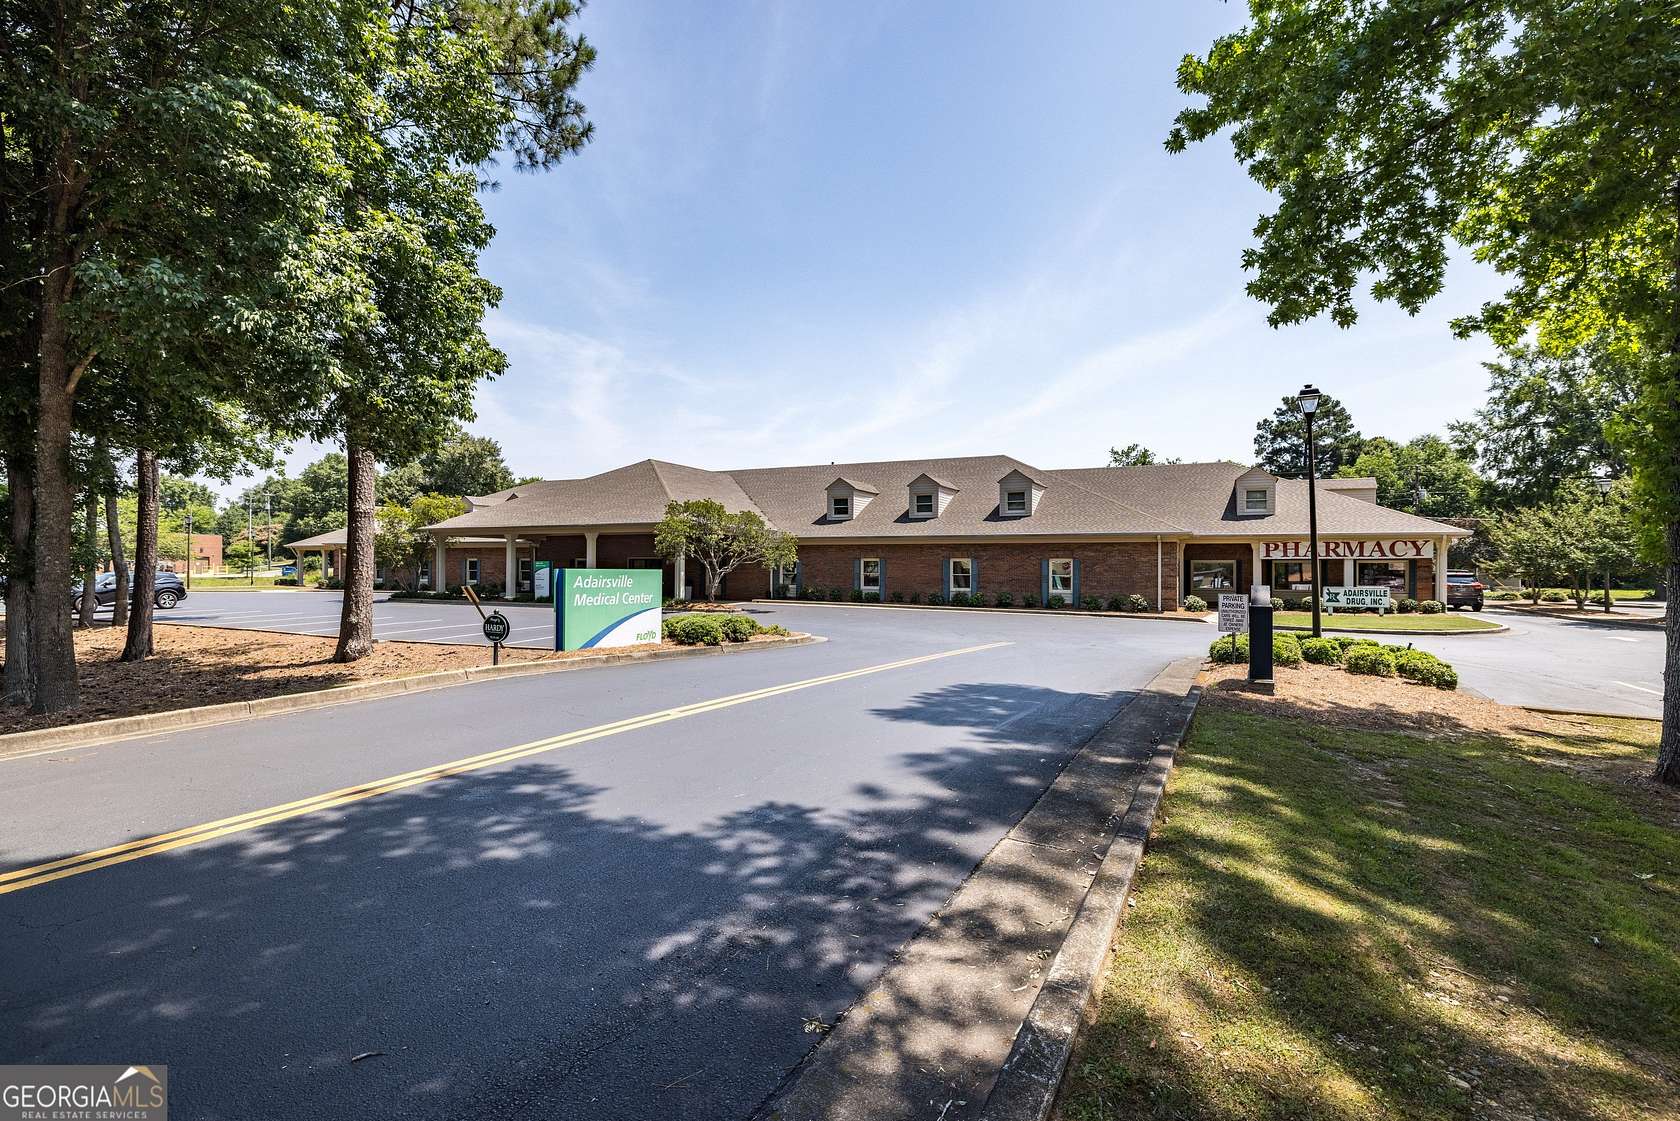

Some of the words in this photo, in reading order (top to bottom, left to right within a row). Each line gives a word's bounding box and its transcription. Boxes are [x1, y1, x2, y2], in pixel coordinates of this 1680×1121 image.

[573, 575, 633, 588] Adairsville
[574, 592, 619, 606] Medical
[622, 592, 654, 605] Center
[485, 623, 505, 632] HARDY
[636, 630, 657, 641] FLOYD
